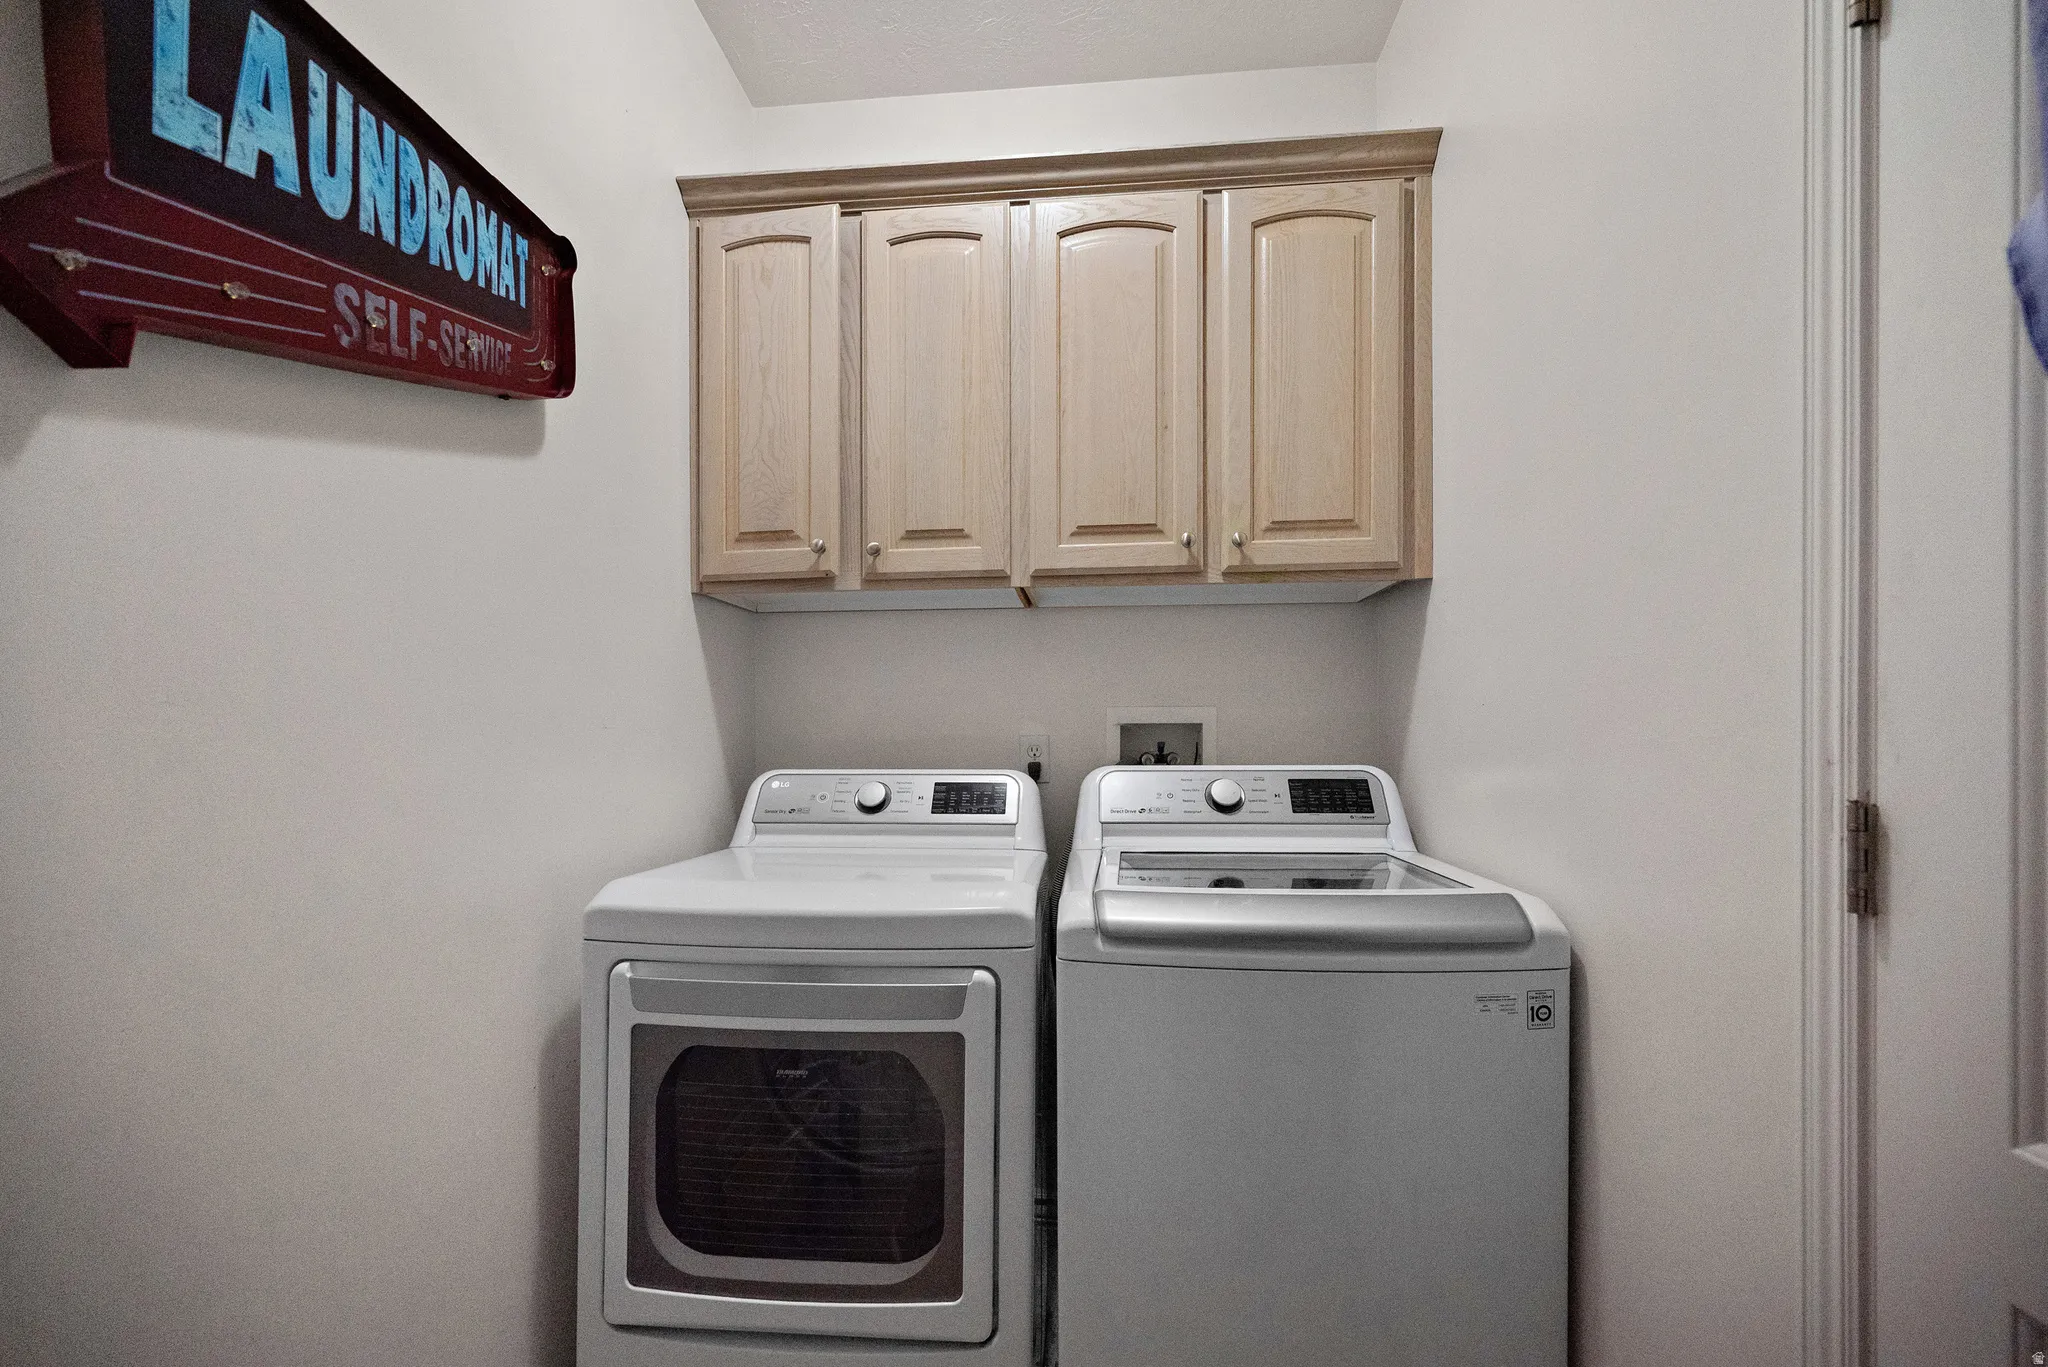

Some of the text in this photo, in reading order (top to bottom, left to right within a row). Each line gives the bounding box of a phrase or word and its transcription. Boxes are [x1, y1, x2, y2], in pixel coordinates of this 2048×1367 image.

[152, 0, 530, 309] LAUNDROMAT
[333, 282, 512, 376] SELF-SERVICE
[1530, 1005, 1552, 1022] 10
